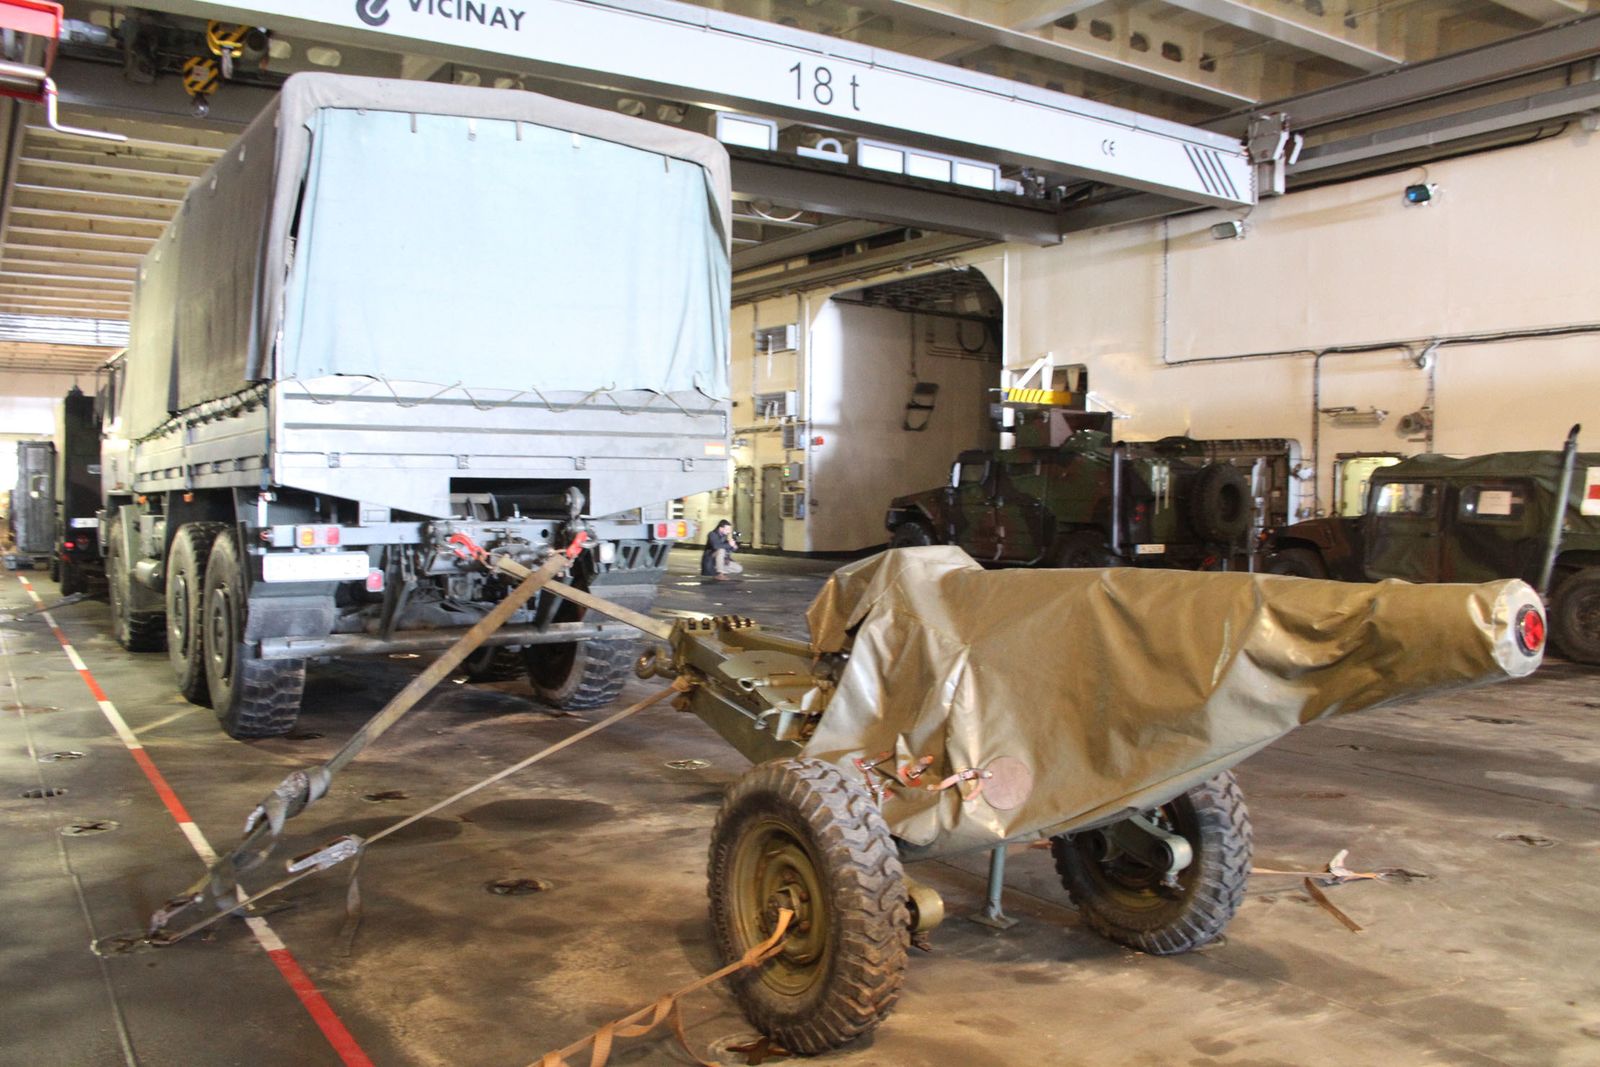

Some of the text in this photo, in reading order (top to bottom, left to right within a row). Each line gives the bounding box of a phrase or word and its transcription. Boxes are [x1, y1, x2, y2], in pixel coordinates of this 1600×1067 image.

[408, 0, 526, 31] VICINAY
[789, 61, 860, 111] 18 t
